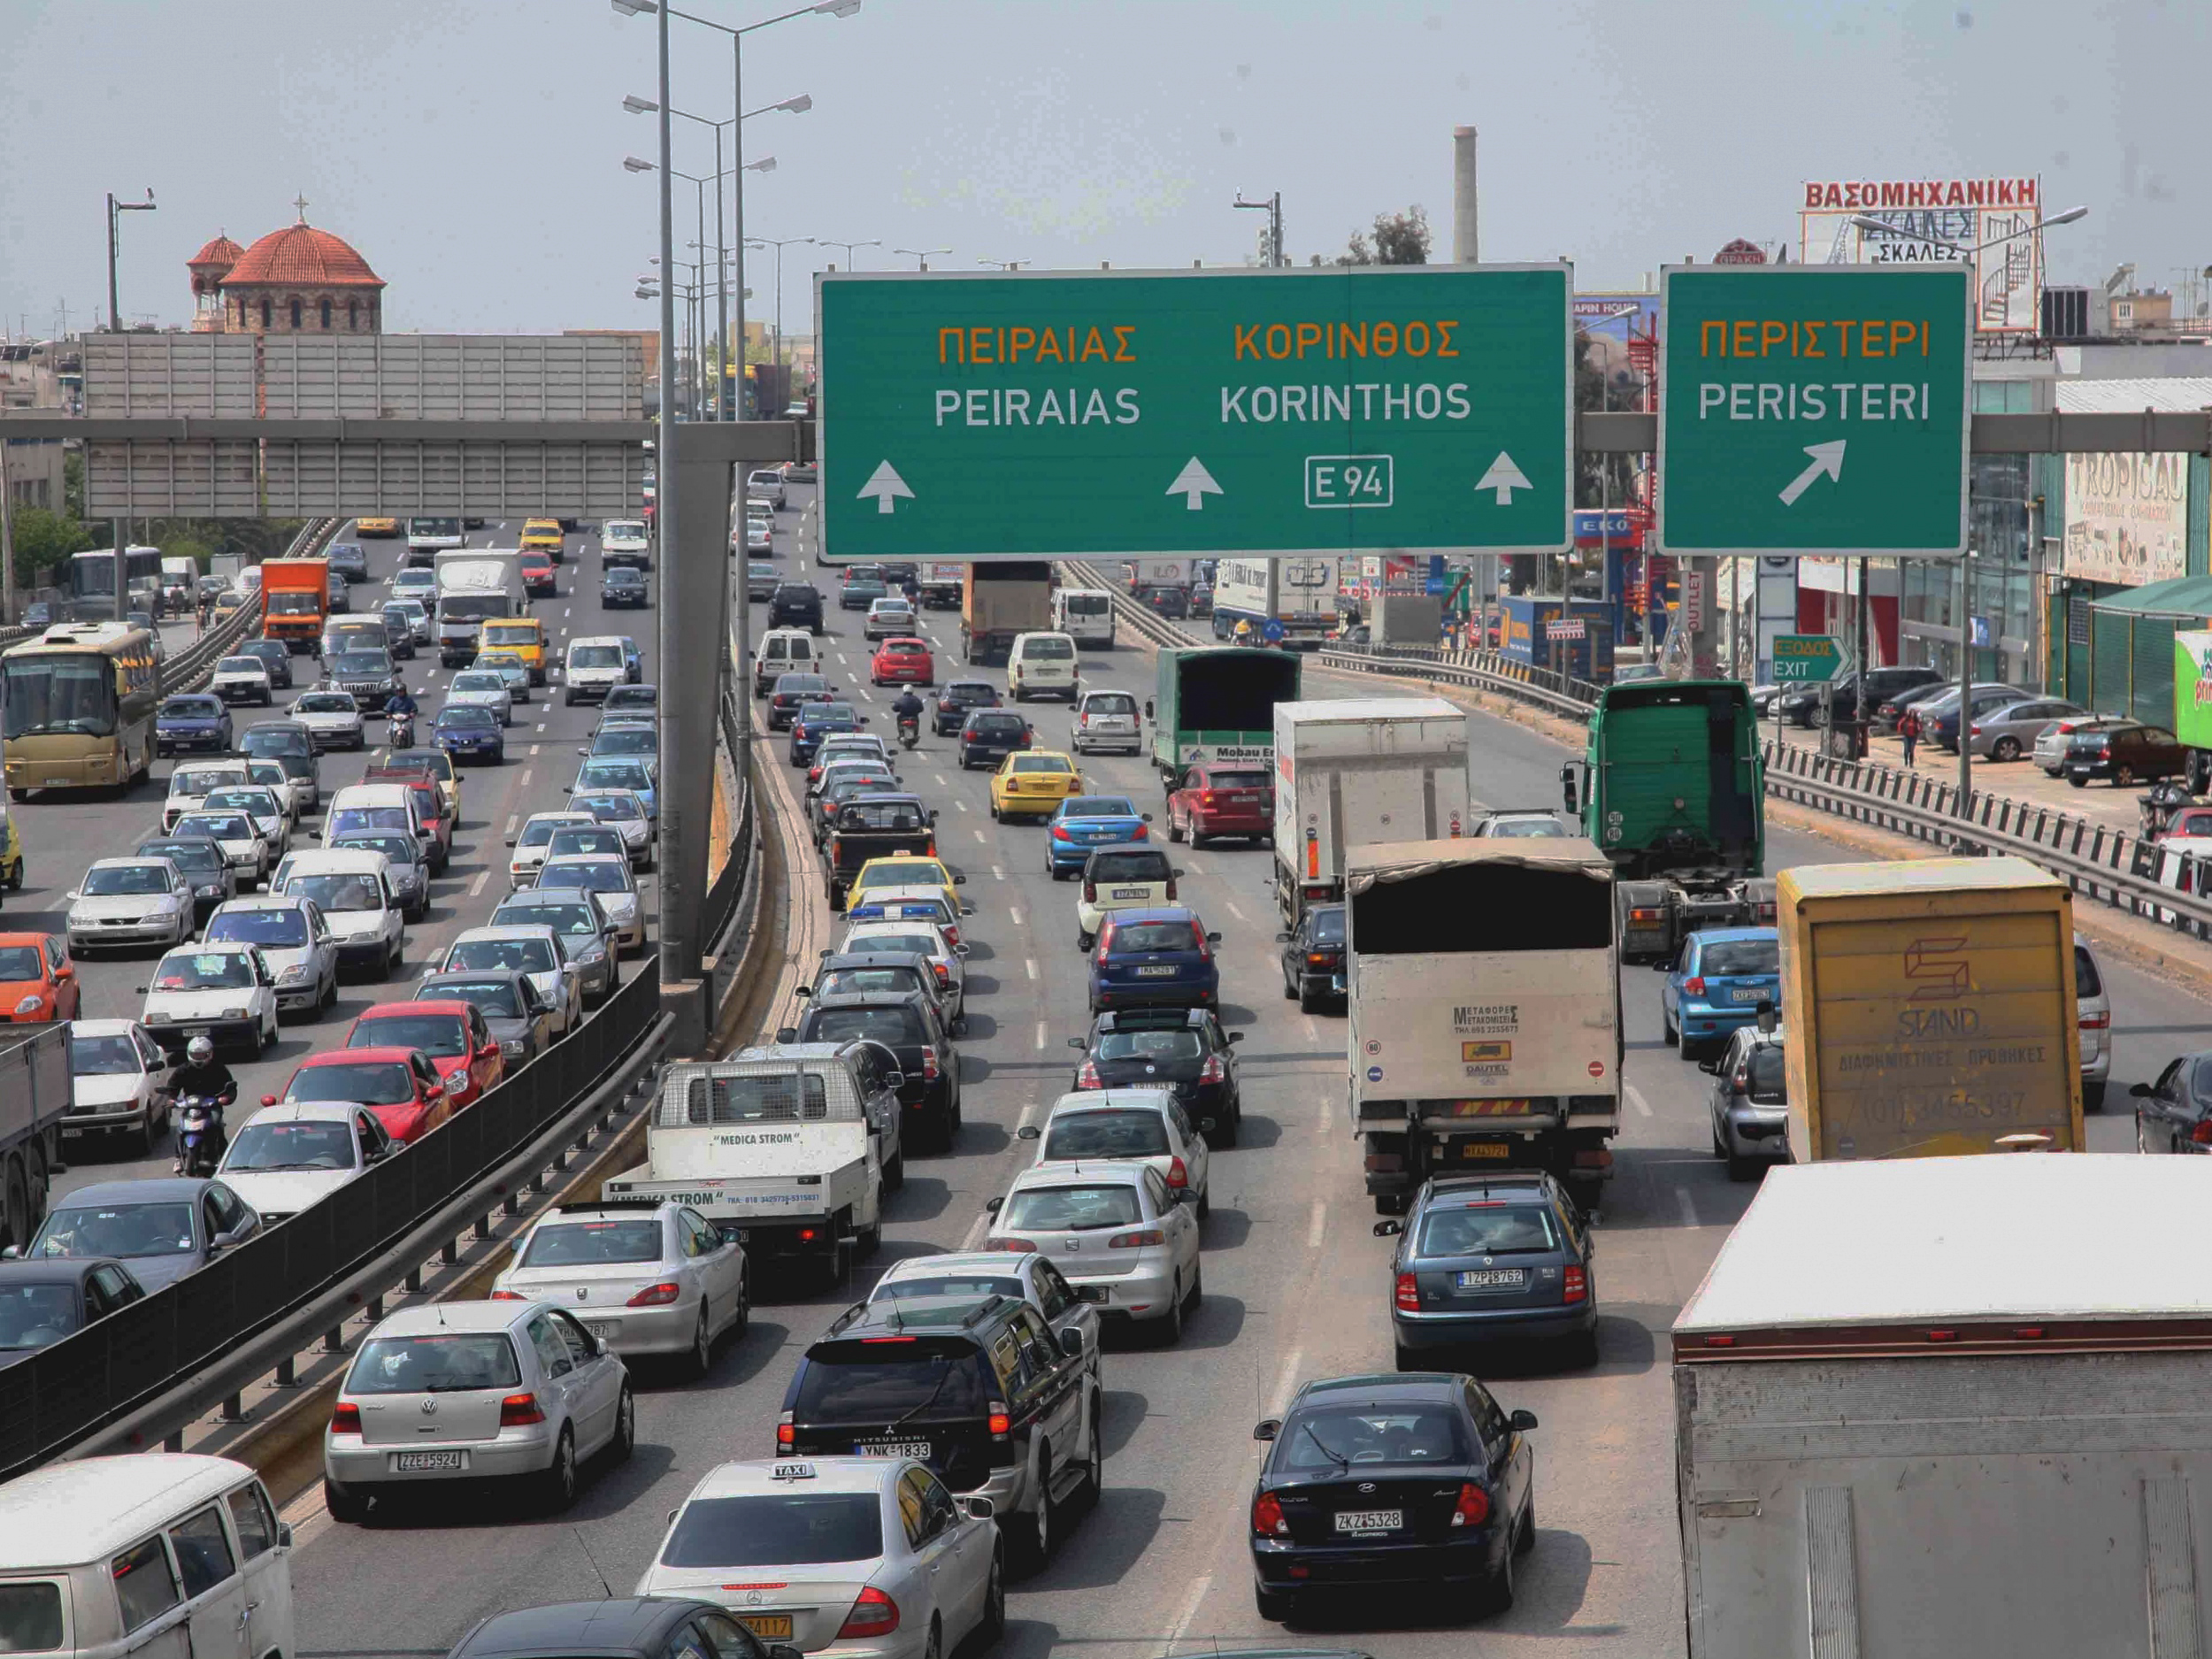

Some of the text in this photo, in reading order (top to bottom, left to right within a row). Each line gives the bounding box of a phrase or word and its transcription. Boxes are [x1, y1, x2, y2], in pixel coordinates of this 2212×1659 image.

[1805, 179, 2035, 208] ΒΑΣΟΜΗΧΑΝΙΚΗ
[1879, 243, 1957, 262] ΣΚΑΛΕΣ
[939, 326, 1137, 364] ΠΕΙΡΑΙΑΣ
[1235, 320, 1460, 360] ΚΟΡΙΝΘΟΣ
[1701, 320, 1930, 357] ΠΕΡΙΣΤΕΡΙ
[935, 388, 1141, 426] PEIRAIAS
[1221, 382, 1471, 423] KORINTHOS
[1700, 382, 1929, 420] PERISTERI
[2070, 452, 2184, 502] TROPICAL
[1688, 572, 1700, 632] OUTLET
[1774, 640, 1832, 657] ΕΞΟΔΟΣ
[1774, 661, 1809, 677] EXIT
[1217, 747, 1260, 757] Mobau
[1899, 1007, 1979, 1036] STAND
[776, 1465, 806, 1476] TAXI
